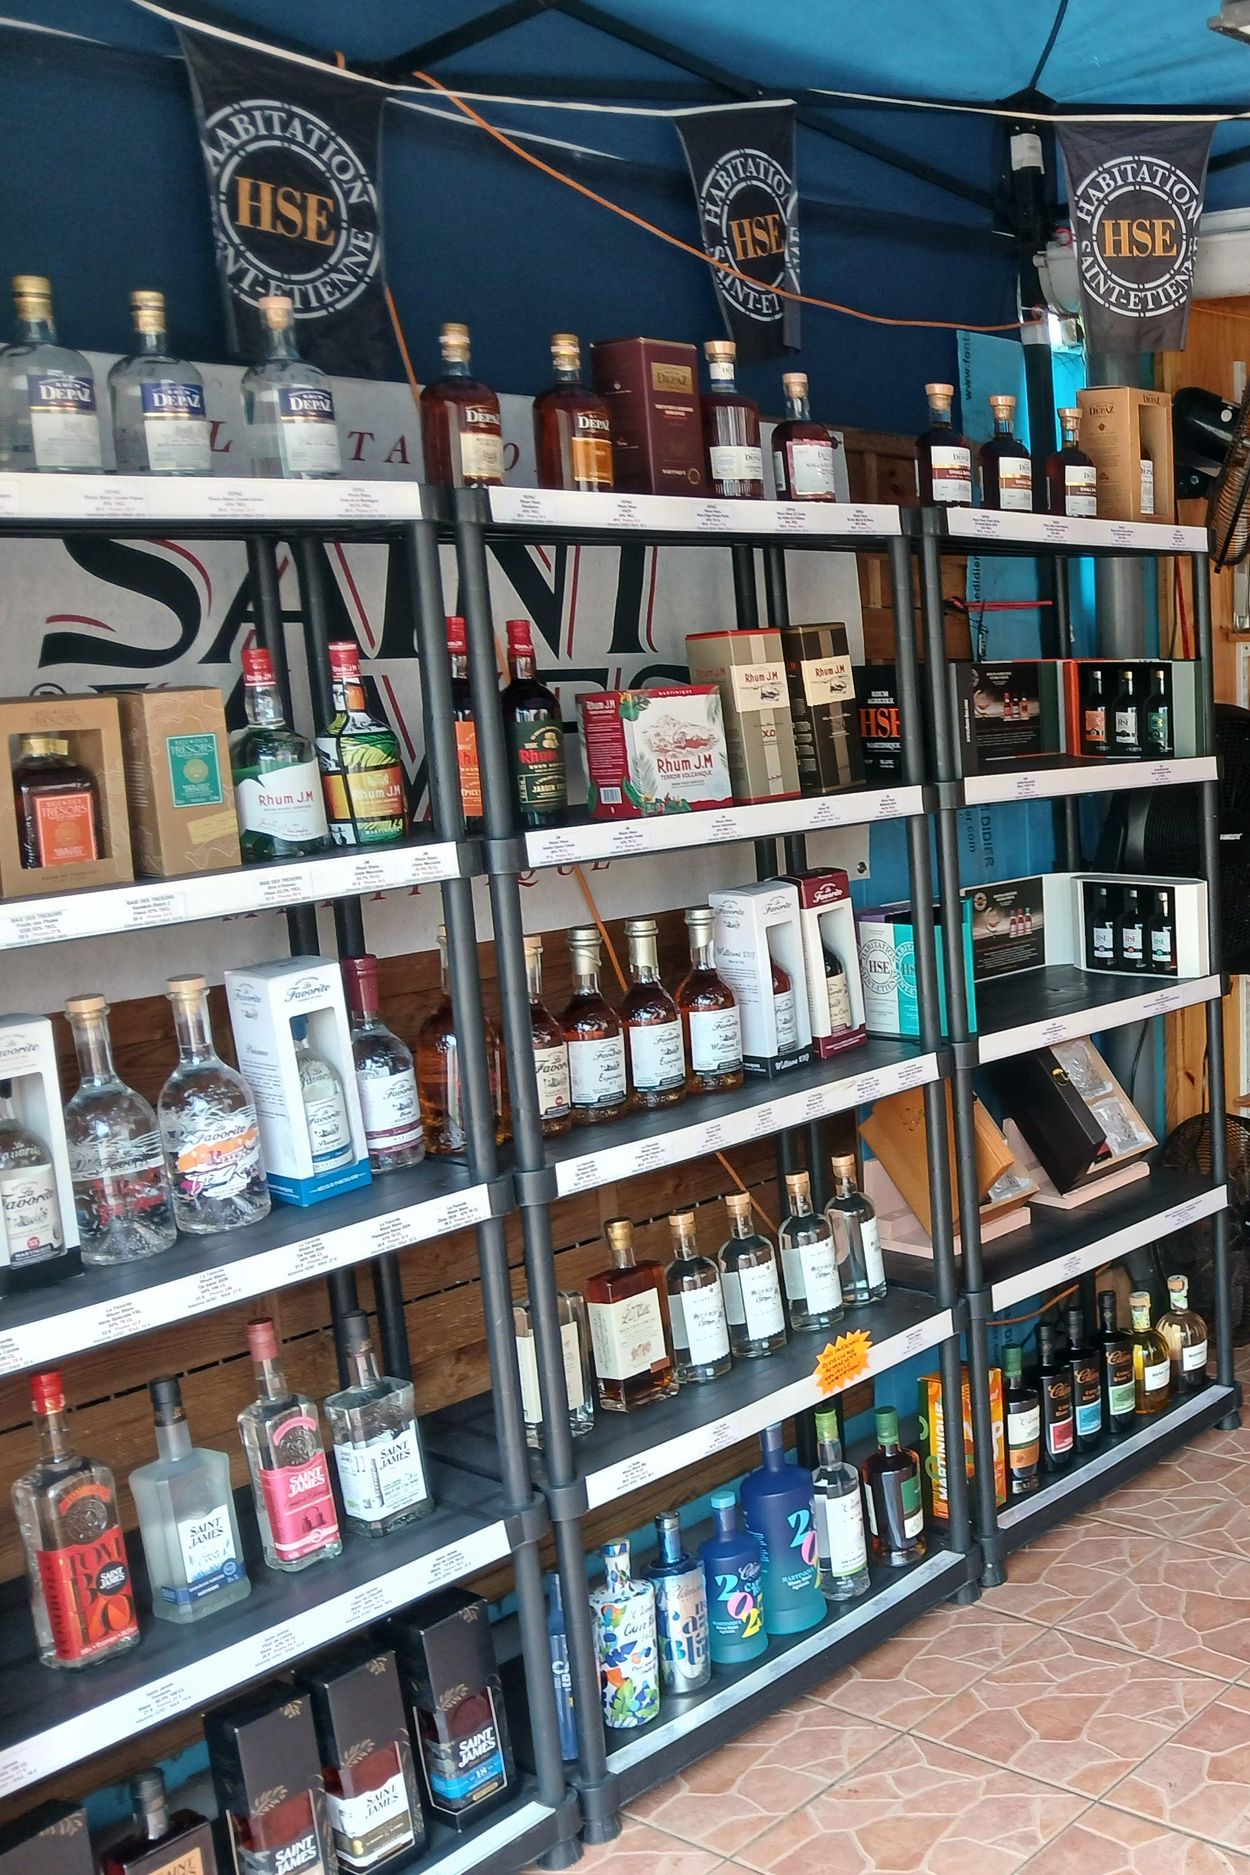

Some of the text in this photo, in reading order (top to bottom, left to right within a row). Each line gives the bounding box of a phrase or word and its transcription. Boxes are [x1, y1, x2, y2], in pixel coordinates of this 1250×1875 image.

[1077, 163, 1199, 224] HABITATION
[234, 176, 335, 246] HSE
[729, 213, 786, 261] HSE
[1102, 219, 1178, 258] HSE
[39, 384, 91, 402] DEPAZ
[153, 391, 201, 408] DEPAZ
[289, 397, 332, 414] DEPAZ
[745, 671, 779, 683] Rhum J.M
[815, 665, 846, 678] Rhum J.M
[171, 743, 215, 755] TRESORS
[657, 754, 714, 774] Rhum J.M
[660, 771, 713, 781] TERROIR VOLCANIQUE
[258, 790, 314, 806] Rhum J.M
[41, 804, 87, 818] TRESORS
[813, 889, 844, 903] Favorite
[763, 902, 793, 915] Favorite
[869, 960, 891, 975] HSE
[285, 984, 331, 1003] Favorite
[381, 1440, 409, 1459] SAINT
[380, 1449, 411, 1471] JAMES
[289, 1465, 323, 1486] SAINT
[288, 1476, 325, 1498] JAMES
[190, 1517, 221, 1537] SAINT
[189, 1528, 224, 1550] JAMES
[99, 1574, 126, 1590] JAMES
[100, 1566, 125, 1581] SAINT
[459, 1726, 494, 1750] SAINT
[458, 1740, 497, 1769] JAMES
[366, 1784, 397, 1807] SAINT
[365, 1794, 400, 1820] JAMES
[276, 1834, 314, 1862] SAINT
[276, 1847, 317, 1875] JAMES
